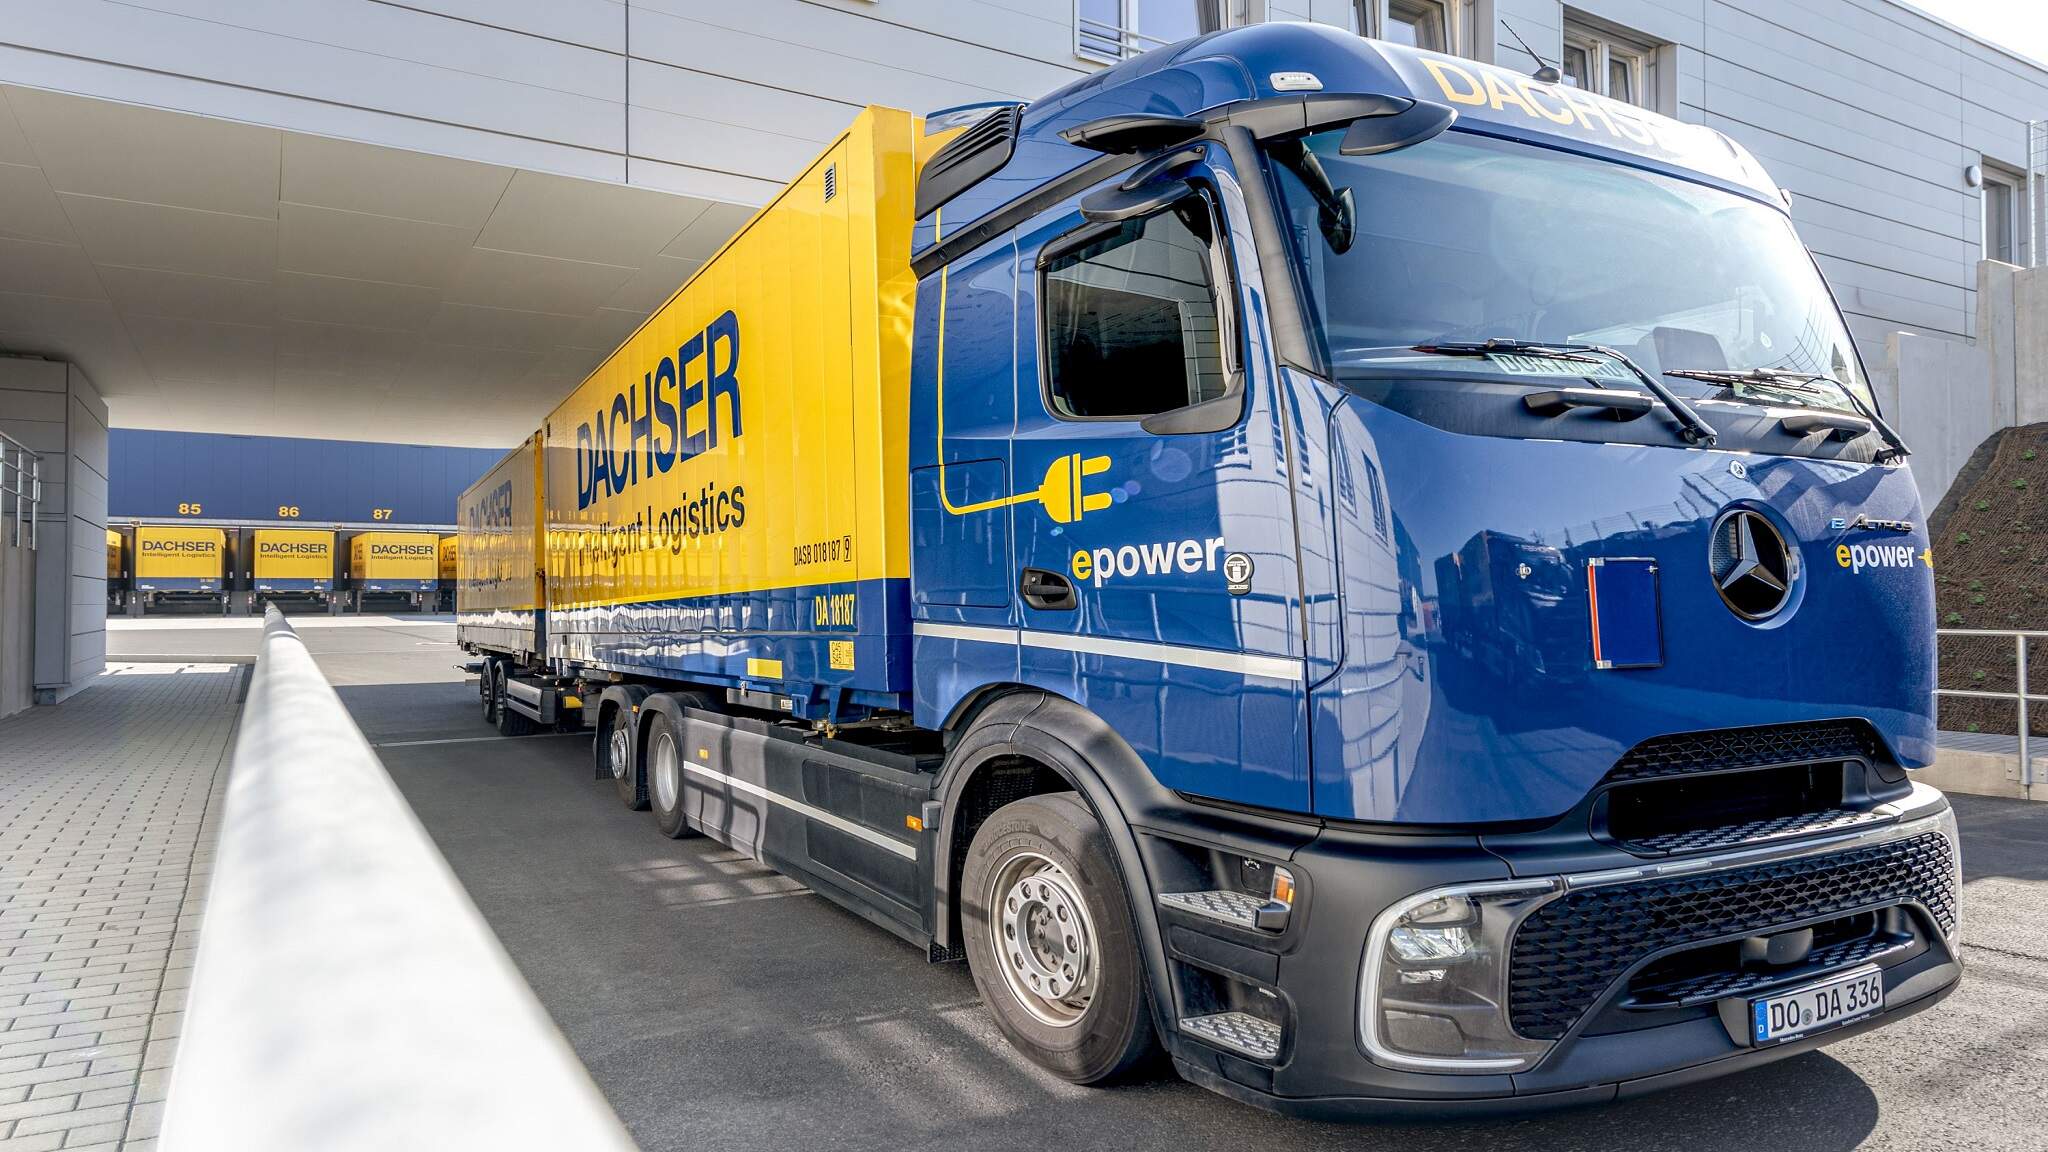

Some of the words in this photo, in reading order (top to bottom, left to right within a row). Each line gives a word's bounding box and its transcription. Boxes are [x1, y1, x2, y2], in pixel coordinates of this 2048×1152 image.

[1418, 57, 1668, 149] DACHS
[577, 310, 742, 511] DACHSER
[178, 503, 202, 515] 85
[278, 506, 300, 518] 86
[373, 509, 393, 520] 87
[648, 481, 745, 556] Logistics
[142, 541, 216, 552] DACHSER
[260, 543, 328, 553] DACHSER
[371, 544, 434, 555] DACHSER
[793, 544, 812, 566] DASB
[813, 540, 841, 564] 018187
[1836, 544, 1915, 574] epower
[1072, 537, 1225, 588] epower
[816, 595, 829, 626] DA
[830, 593, 855, 626] 18187
[1770, 999, 1800, 1033] DO
[1815, 987, 1842, 1022] DA
[1846, 976, 1880, 1012] 336
[1758, 1025, 1764, 1033] D
